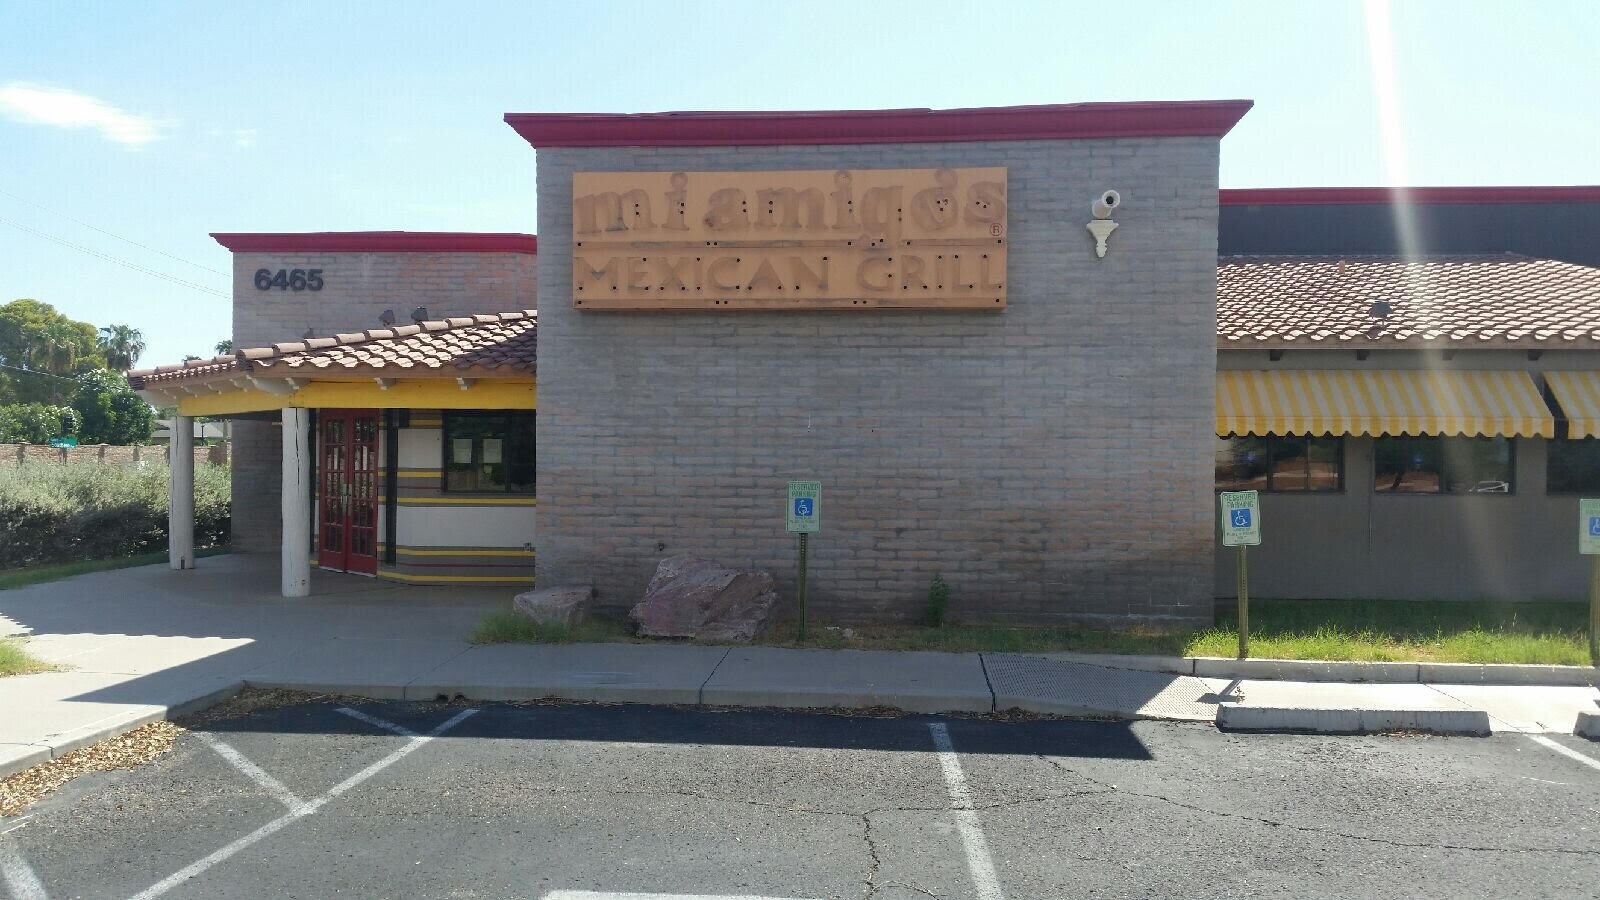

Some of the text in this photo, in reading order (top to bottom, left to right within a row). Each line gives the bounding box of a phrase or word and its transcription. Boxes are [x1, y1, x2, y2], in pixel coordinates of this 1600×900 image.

[573, 168, 1005, 253] mi amigos
[254, 268, 324, 291] 6465
[573, 253, 1003, 292] MEXICAN GRILL
